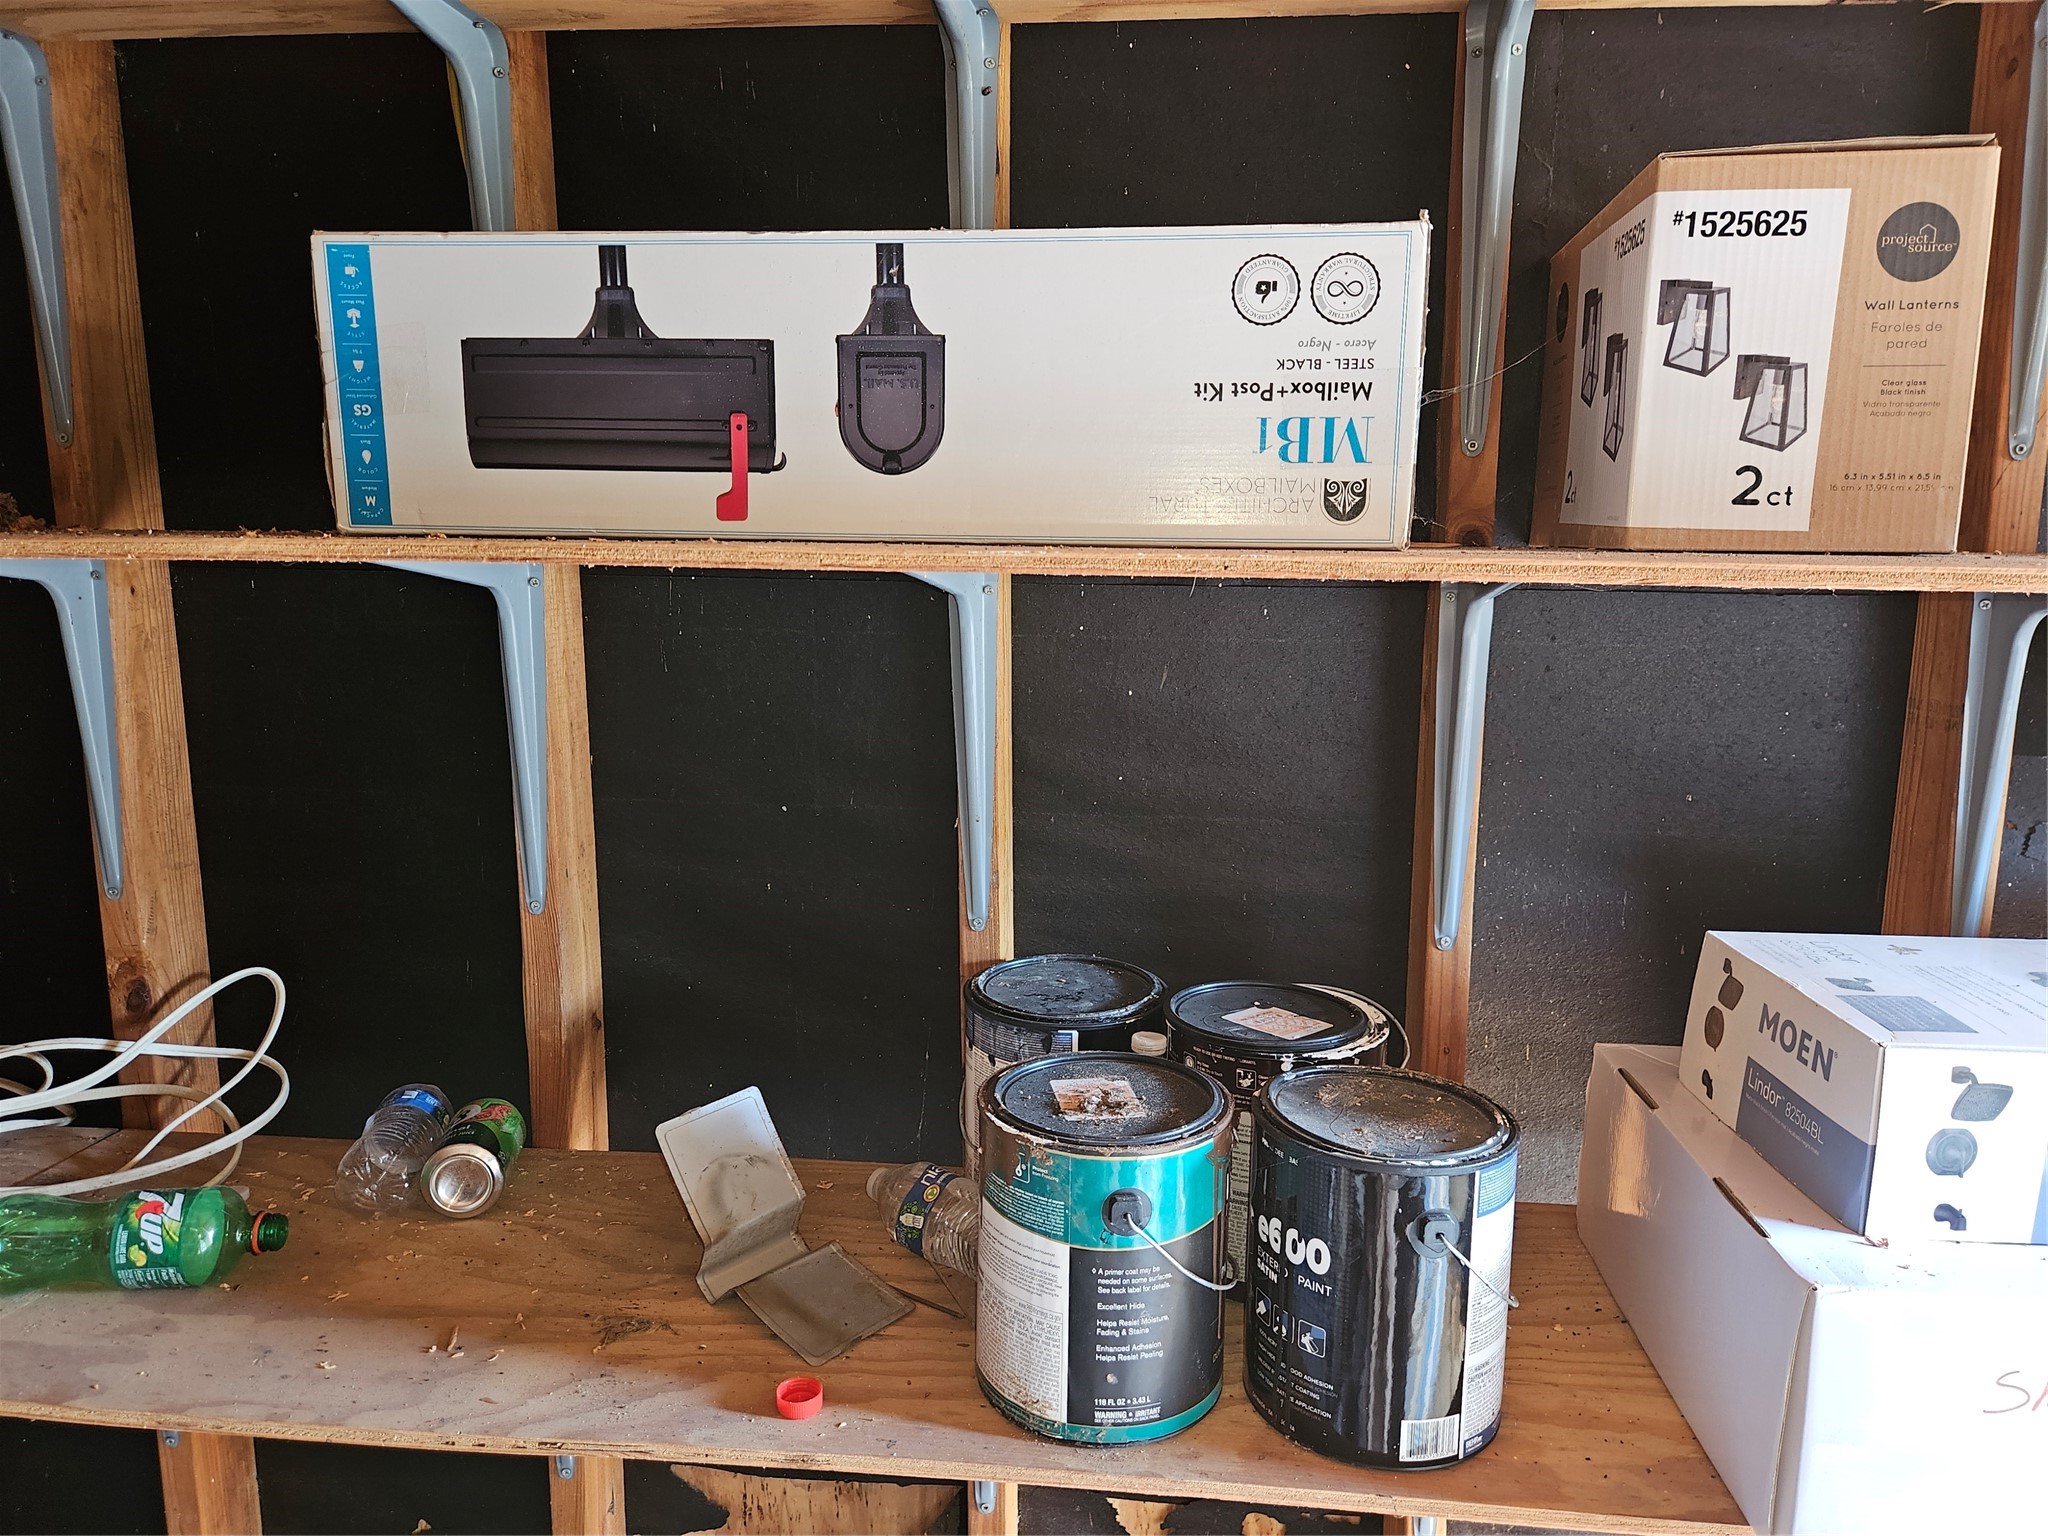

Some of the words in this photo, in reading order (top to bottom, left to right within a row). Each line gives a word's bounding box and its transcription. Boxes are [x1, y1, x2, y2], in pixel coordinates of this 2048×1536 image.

[1673, 209, 1807, 238] #1525625
[1881, 233, 1929, 247] project
[1908, 242, 1953, 253] source
[1245, 259, 1289, 274] GUARANTEED
[1315, 259, 1343, 291] WARRANTY
[1343, 258, 1375, 291] STRUCTURAL
[1237, 297, 1280, 320] SATISFACTION
[1864, 300, 1895, 310] Wall
[1899, 300, 1960, 310] Lanterns
[1327, 309, 1361, 319] LIFETIME
[1871, 321, 1921, 333] Faroles
[1925, 321, 1943, 333] de
[1297, 337, 1333, 352] Negro
[1343, 338, 1377, 351] Acero
[1886, 338, 1928, 351] pared
[1275, 358, 1323, 371] BLACK
[1334, 357, 1375, 370] STEEL
[1881, 379, 1903, 387] Clear
[1905, 379, 1927, 388] glass
[1193, 382, 1224, 402] Kit
[353, 404, 372, 416] GS
[1889, 401, 1941, 409] transparente
[1907, 410, 1932, 418] negro
[1255, 416, 1375, 464] MB1
[1844, 472, 1858, 480] 6.3
[1860, 472, 1868, 480] in
[1879, 472, 1896, 480] 5.51
[1898, 472, 1906, 480] in
[1933, 472, 1941, 480] in
[1199, 477, 1317, 494] MAILBOXES
[1829, 484, 1838, 492] 16
[365, 495, 376, 507] M
[1758, 1003, 1834, 1082] MOEN
[1784, 1102, 1824, 1144] 82504BL
[1104, 1268, 1124, 1276] primer
[1256, 1259, 1278, 1284] SATIN
[1097, 1286, 1110, 1294] See
[1111, 1285, 1127, 1294] back
[1127, 1285, 1142, 1293] label
[1298, 1275, 1333, 1297] PAINT
[1097, 1302, 1128, 1310] Excellent
[1129, 1302, 1146, 1310] Hide
[1096, 1319, 1117, 1329] Helps
[1118, 1319, 1140, 1327] Resist
[1096, 1328, 1120, 1338] Fading
[1121, 1328, 1127, 1336] &
[1128, 1327, 1149, 1335] Stains
[1096, 1344, 1131, 1353] Enhanced
[1131, 1341, 1162, 1351] Adhesion
[1095, 1354, 1116, 1363] Helps
[1117, 1353, 1139, 1361] Resist
[1140, 1349, 1164, 1359] Peeling
[1303, 1372, 1334, 1391] ADHESION
[1294, 1384, 1321, 1401] COATING
[1107, 1398, 1115, 1406] FL
[1132, 1396, 1146, 1405] 3.43
[1094, 1411, 1127, 1419] WARNING
[1135, 1406, 1162, 1418] IRRITANT
[1294, 1399, 1332, 1419] APPLICATION
